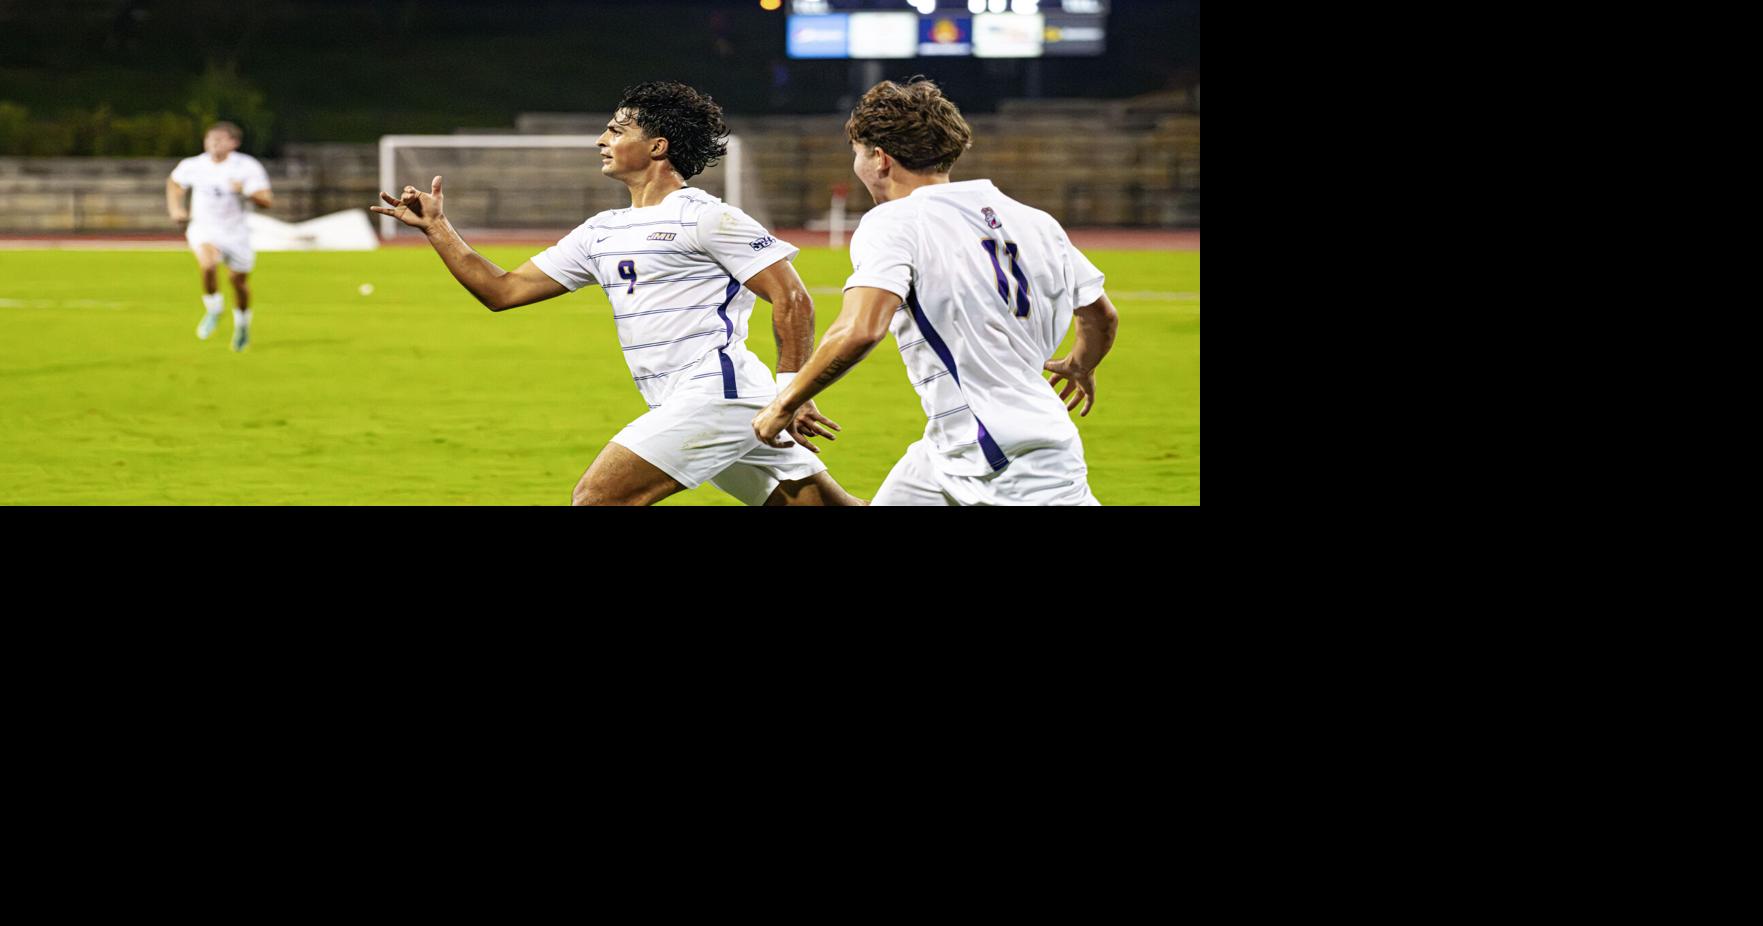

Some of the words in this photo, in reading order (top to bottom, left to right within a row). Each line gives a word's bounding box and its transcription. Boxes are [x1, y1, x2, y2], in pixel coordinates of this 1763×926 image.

[647, 232, 677, 241] JMU
[618, 259, 637, 294] 9
[979, 236, 1031, 319] 11
